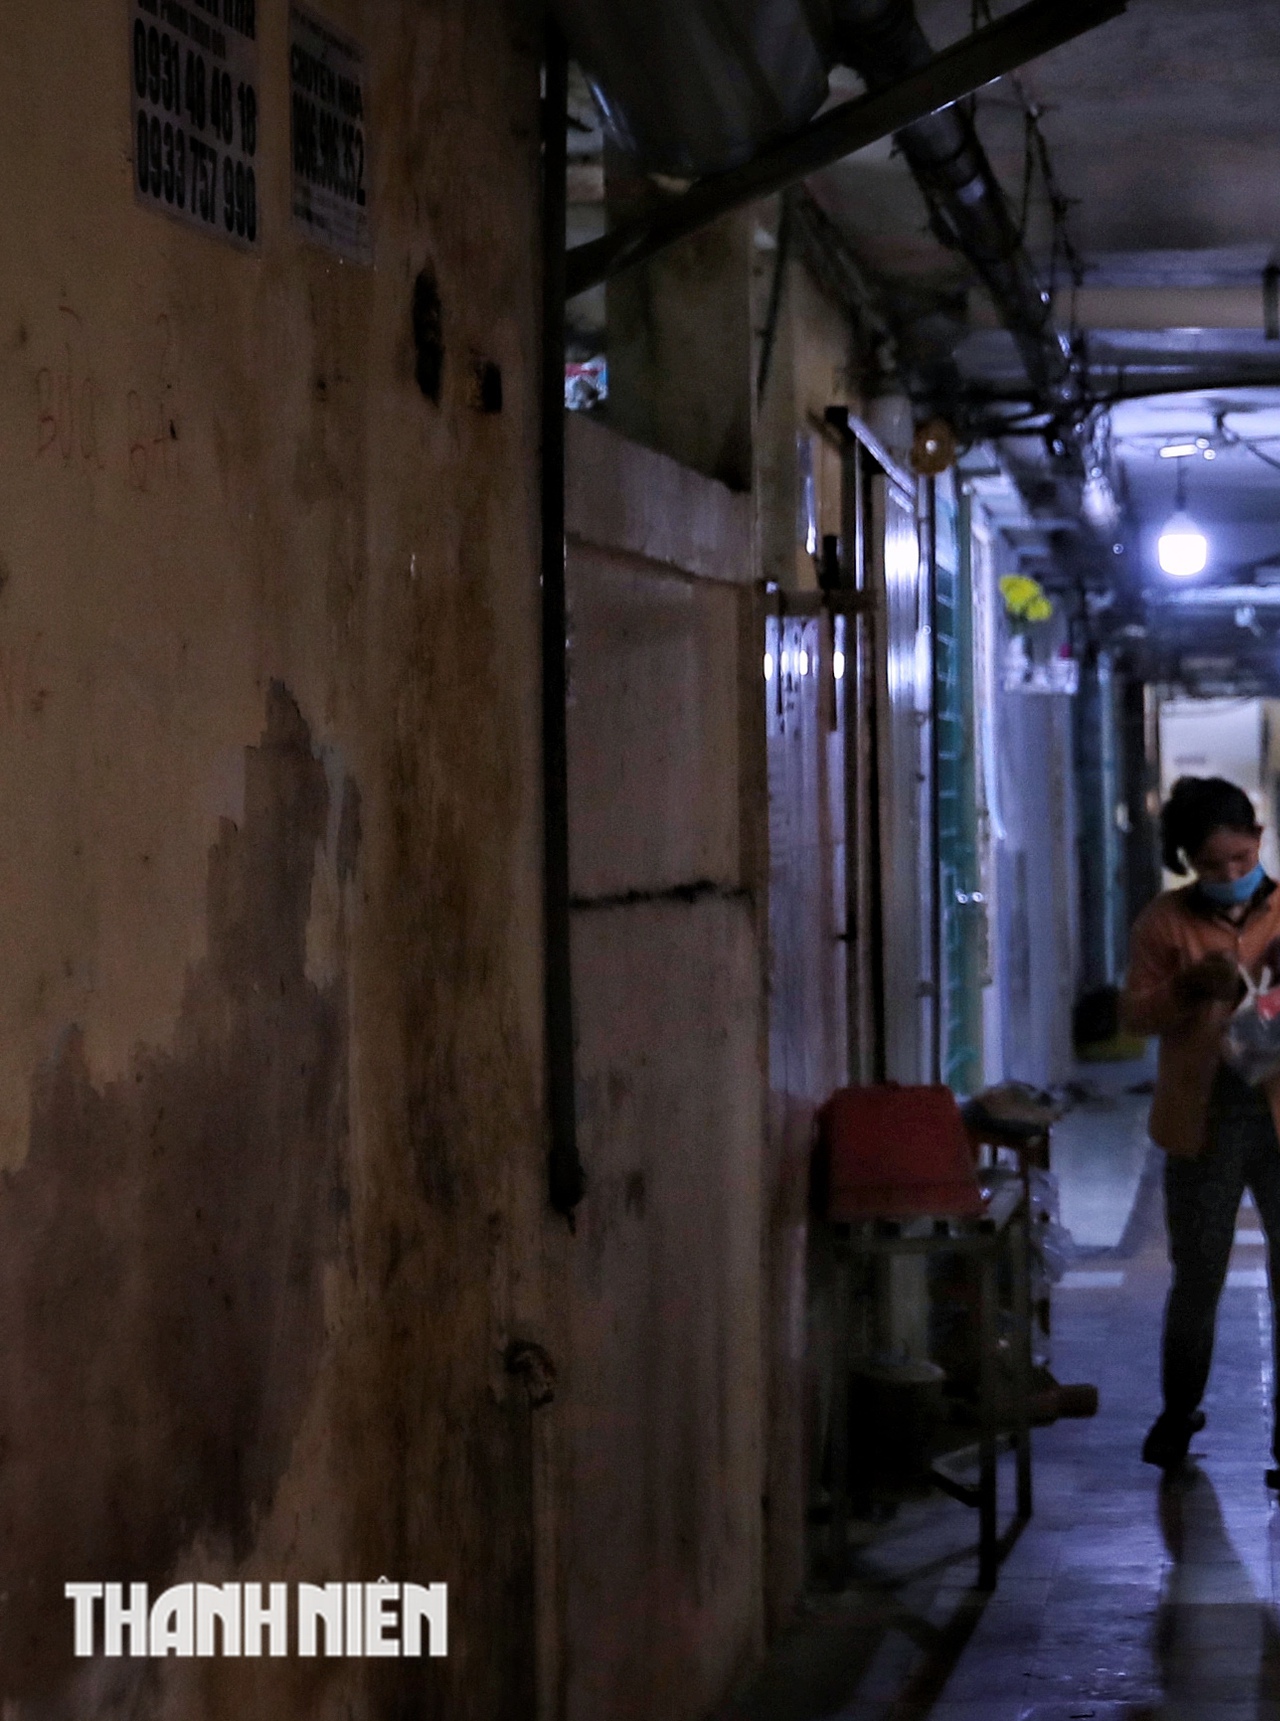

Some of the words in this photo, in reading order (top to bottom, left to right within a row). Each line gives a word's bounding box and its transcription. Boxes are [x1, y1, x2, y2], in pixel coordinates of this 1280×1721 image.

[134, 18, 180, 116] 0931
[186, 50, 205, 131] 48
[211, 67, 232, 145] 48
[238, 81, 256, 157] 18
[137, 109, 185, 209] 0933
[190, 137, 217, 224] 757
[224, 155, 256, 242] 990
